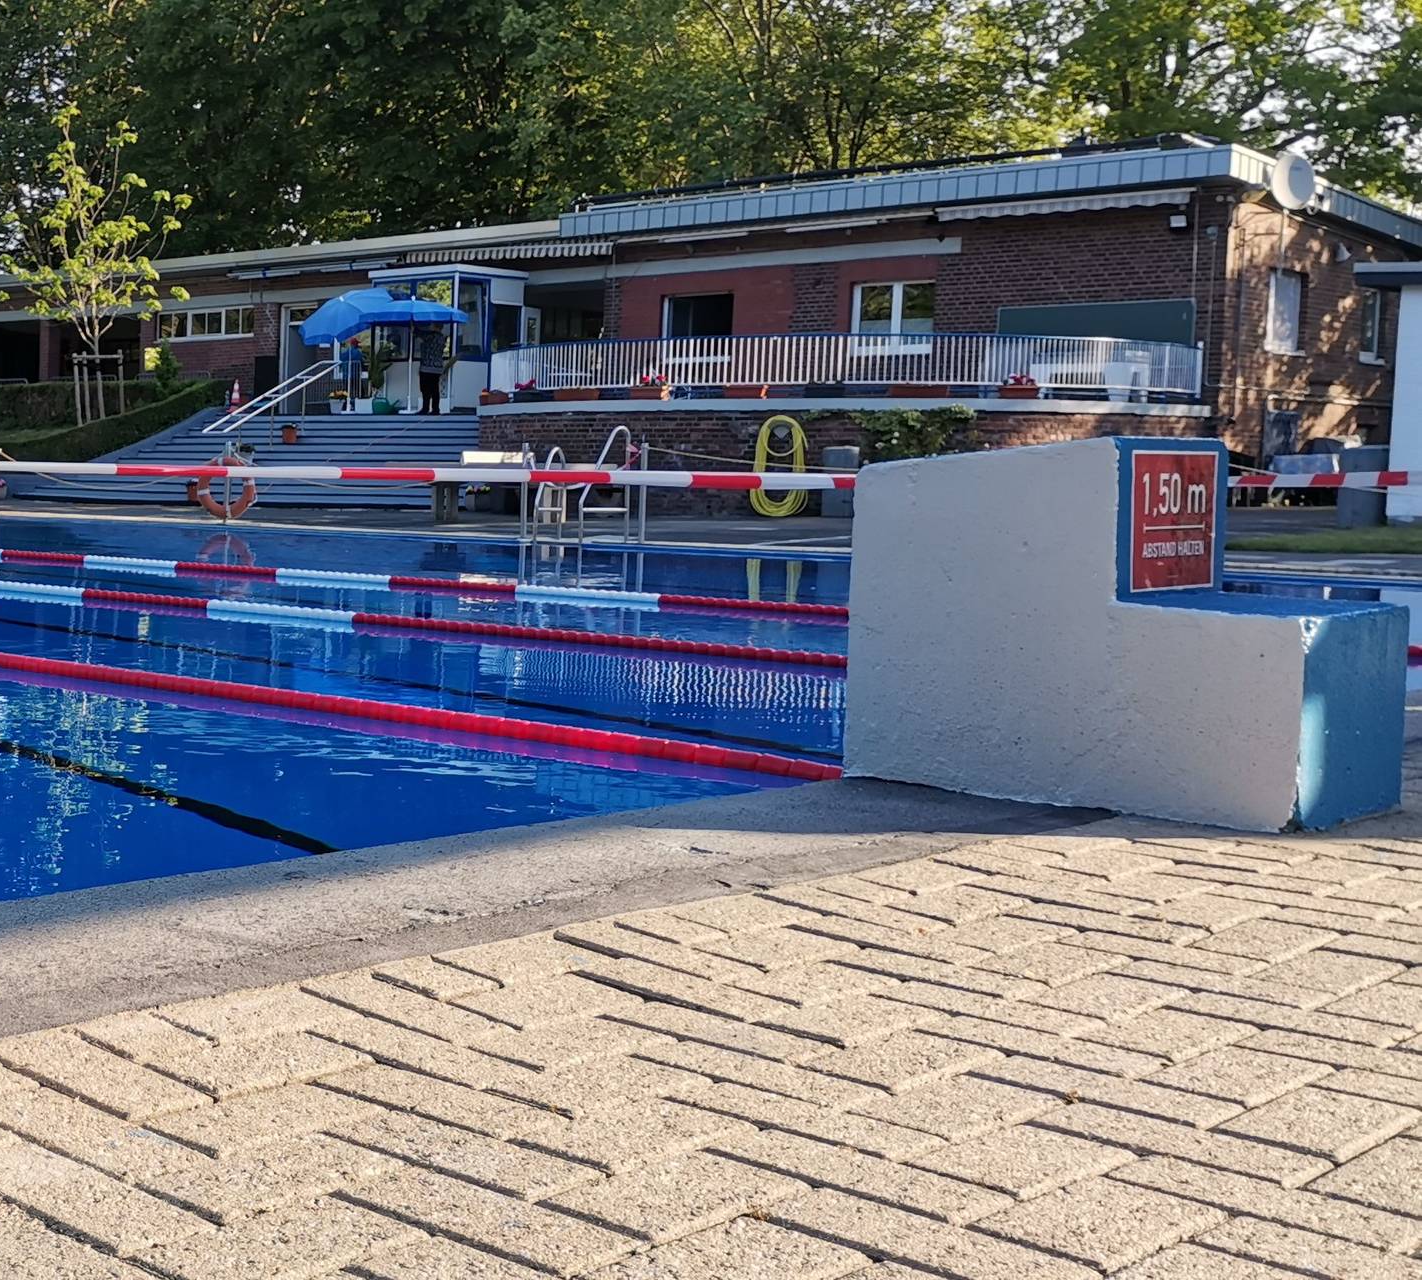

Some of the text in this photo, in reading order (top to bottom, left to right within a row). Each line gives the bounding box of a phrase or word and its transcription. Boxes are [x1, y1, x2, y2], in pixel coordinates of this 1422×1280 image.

[1142, 472, 1206, 518] 1,50 m
[1142, 540, 1205, 559] ABSTAND HALTEN
